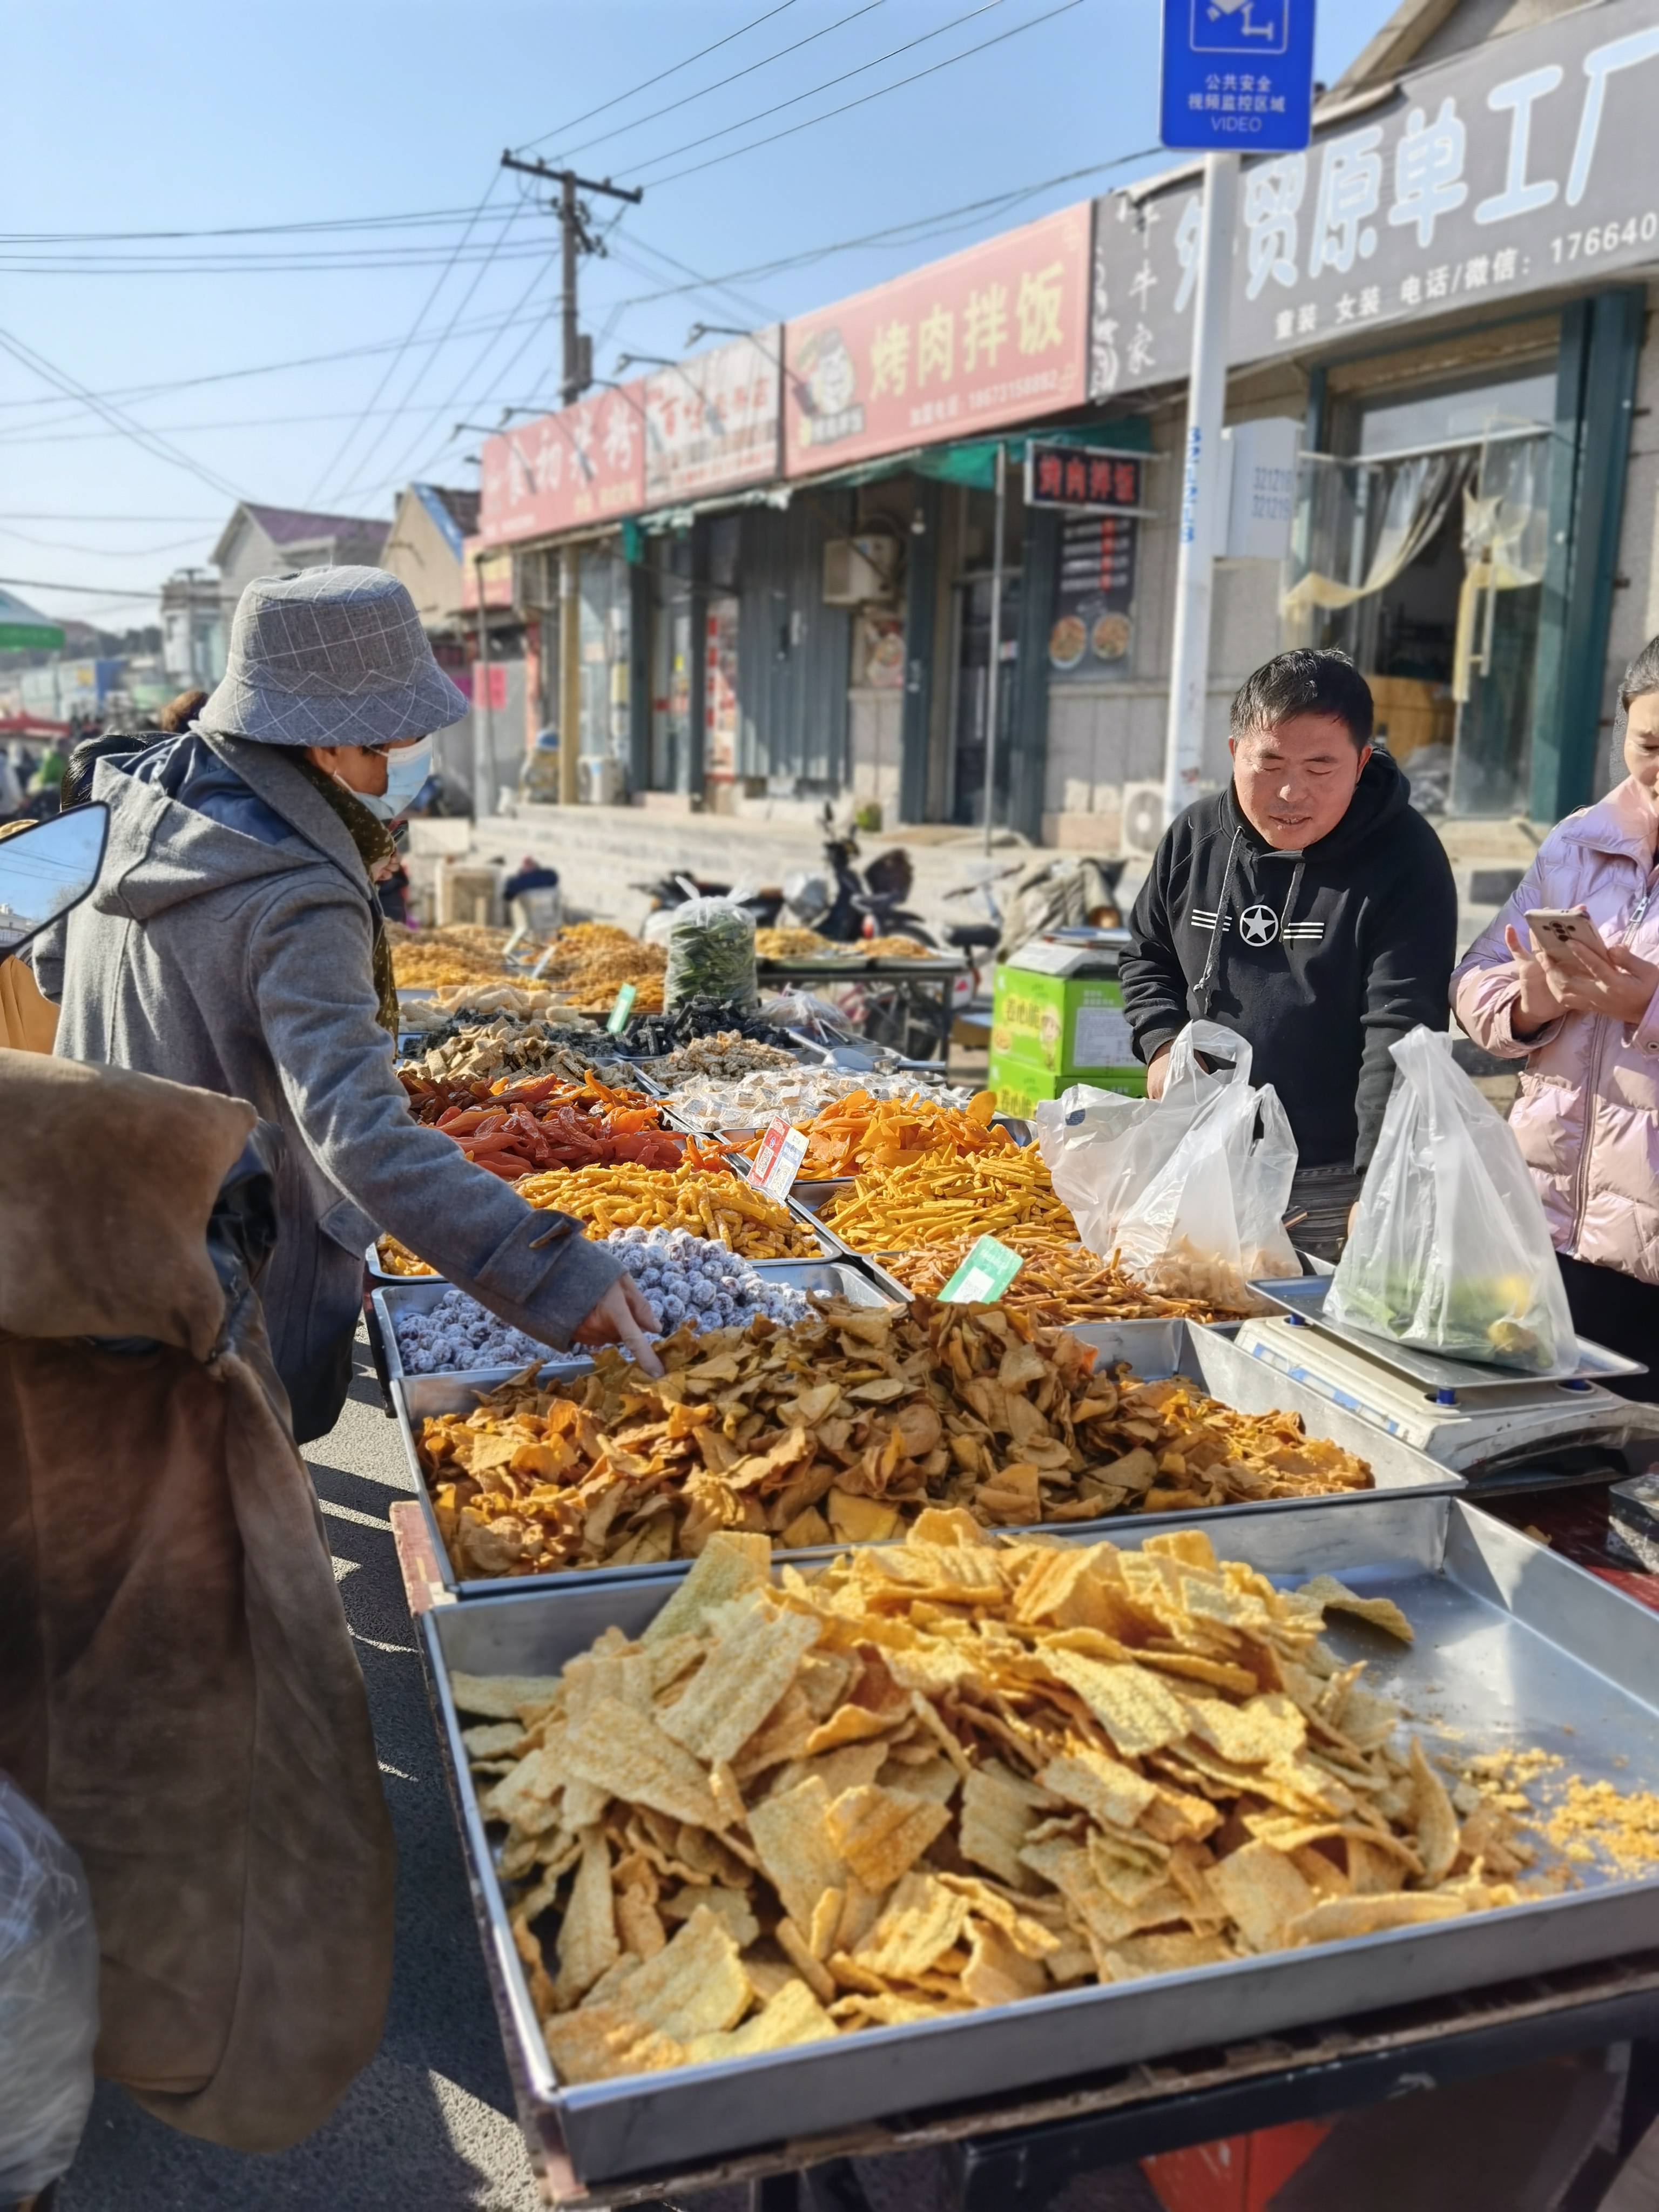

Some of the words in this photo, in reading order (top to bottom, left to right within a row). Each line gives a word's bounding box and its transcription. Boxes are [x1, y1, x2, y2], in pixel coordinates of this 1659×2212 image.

[1205, 73, 1271, 92] 公共安全
[1188, 93, 1285, 113] 视频监控区域
[1211, 116, 1262, 132] VIDEO
[1274, 303, 1318, 341] 童装
[1335, 285, 1381, 323] 女装
[869, 260, 1064, 402] 烤肉拌饭
